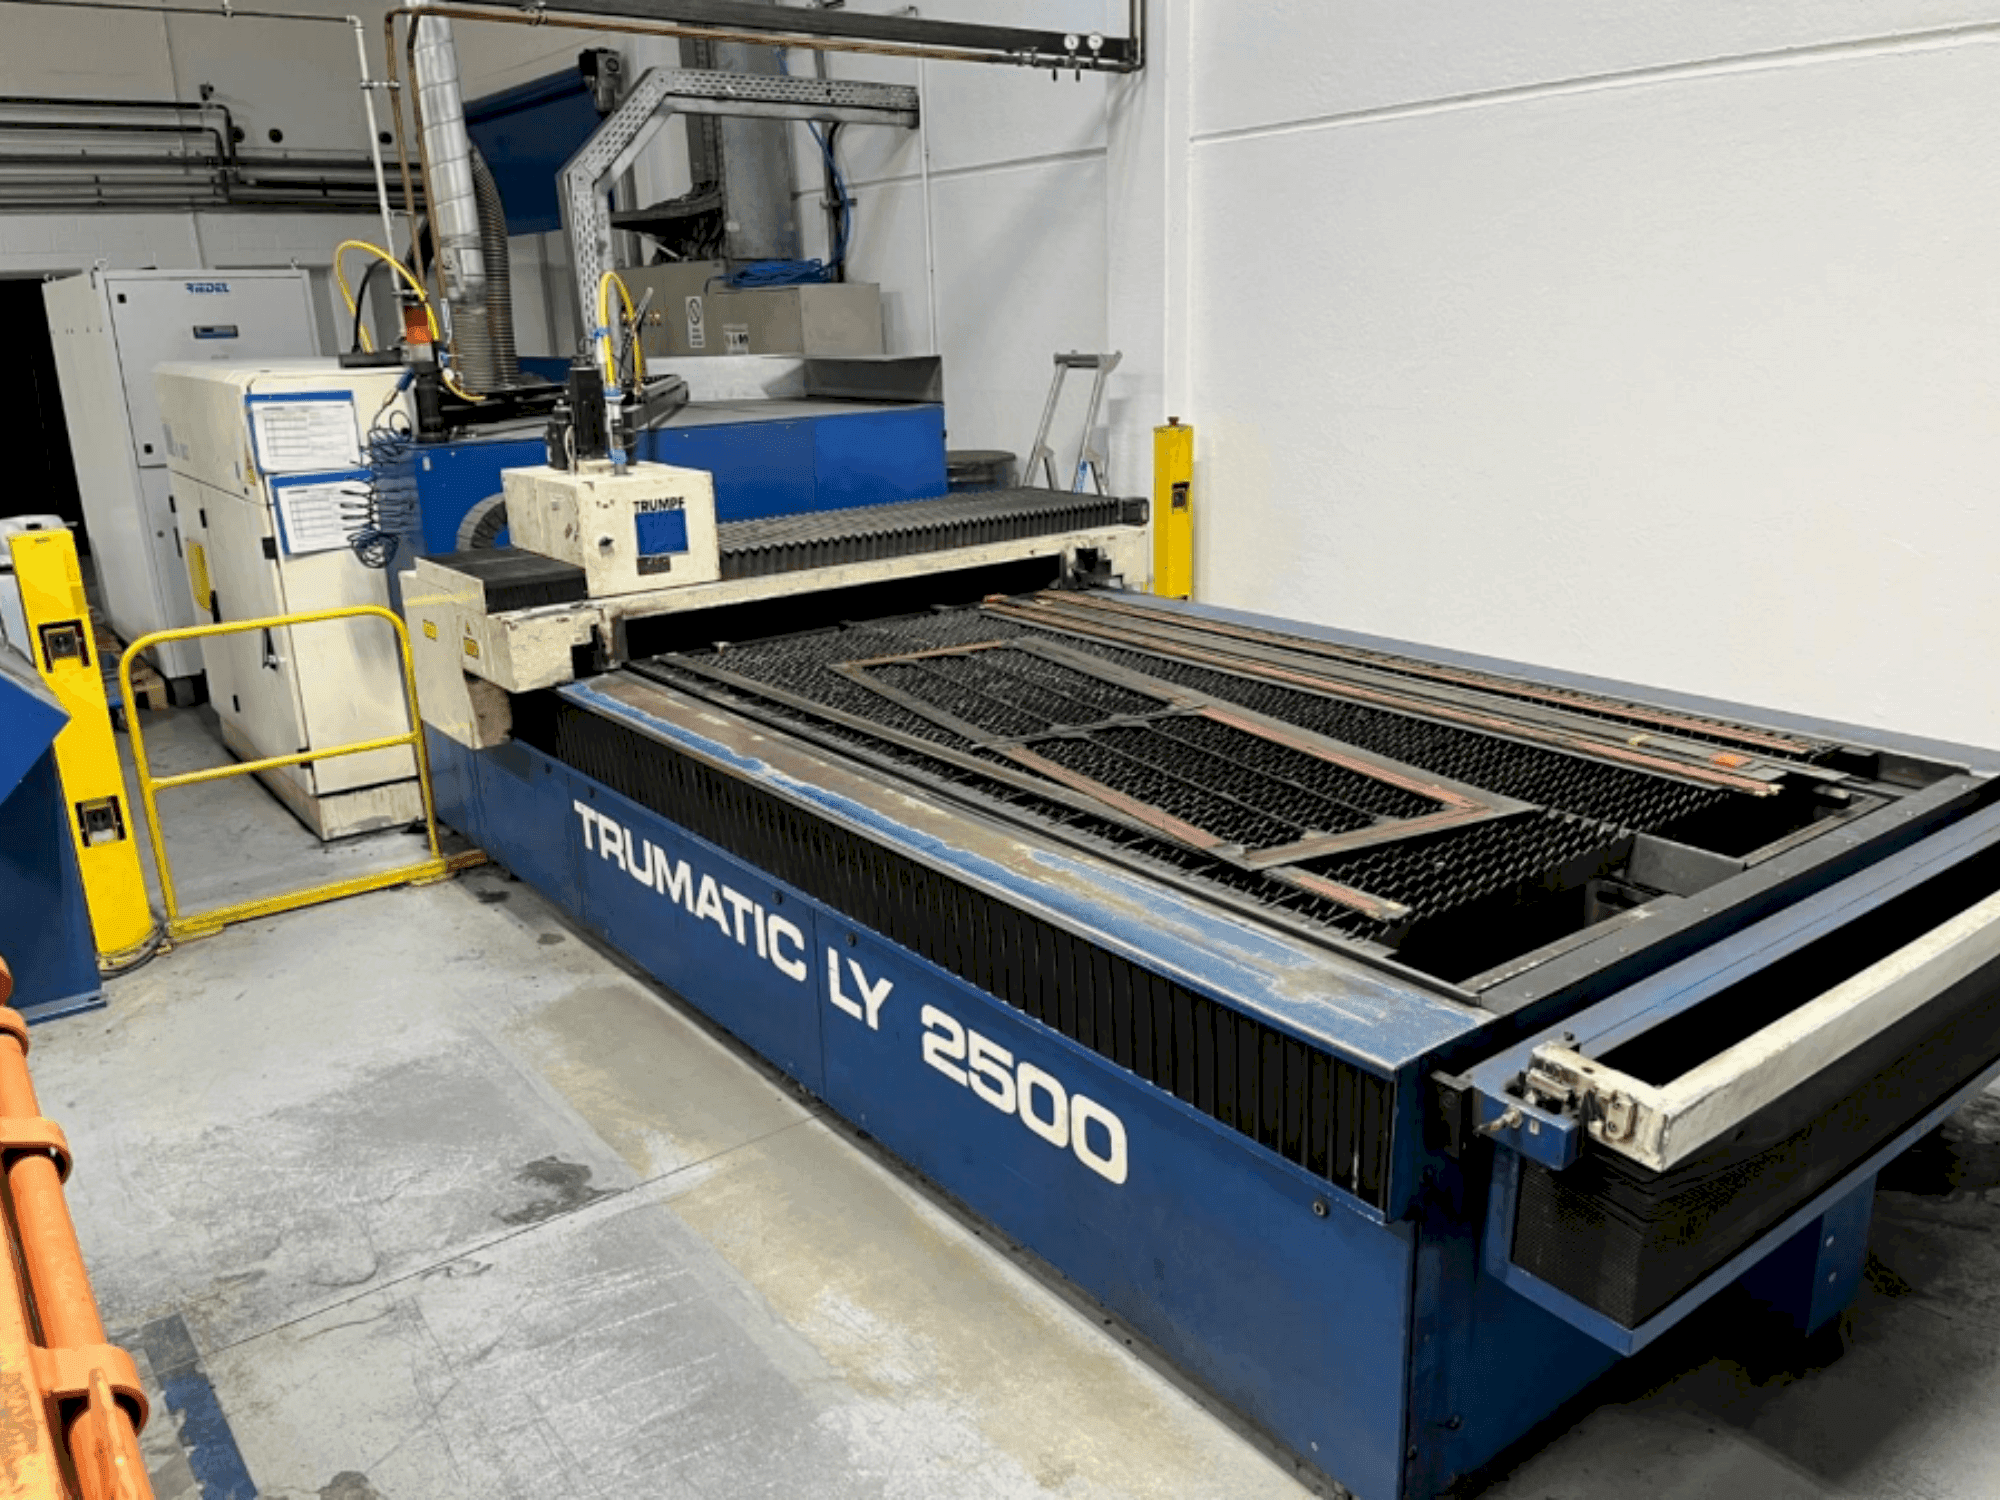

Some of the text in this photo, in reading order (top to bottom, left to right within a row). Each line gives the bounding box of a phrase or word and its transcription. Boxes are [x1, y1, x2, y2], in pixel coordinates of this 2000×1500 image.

[633, 496, 685, 513] TRUMPF
[573, 800, 1128, 1185] TRUMATIC LY 2500
